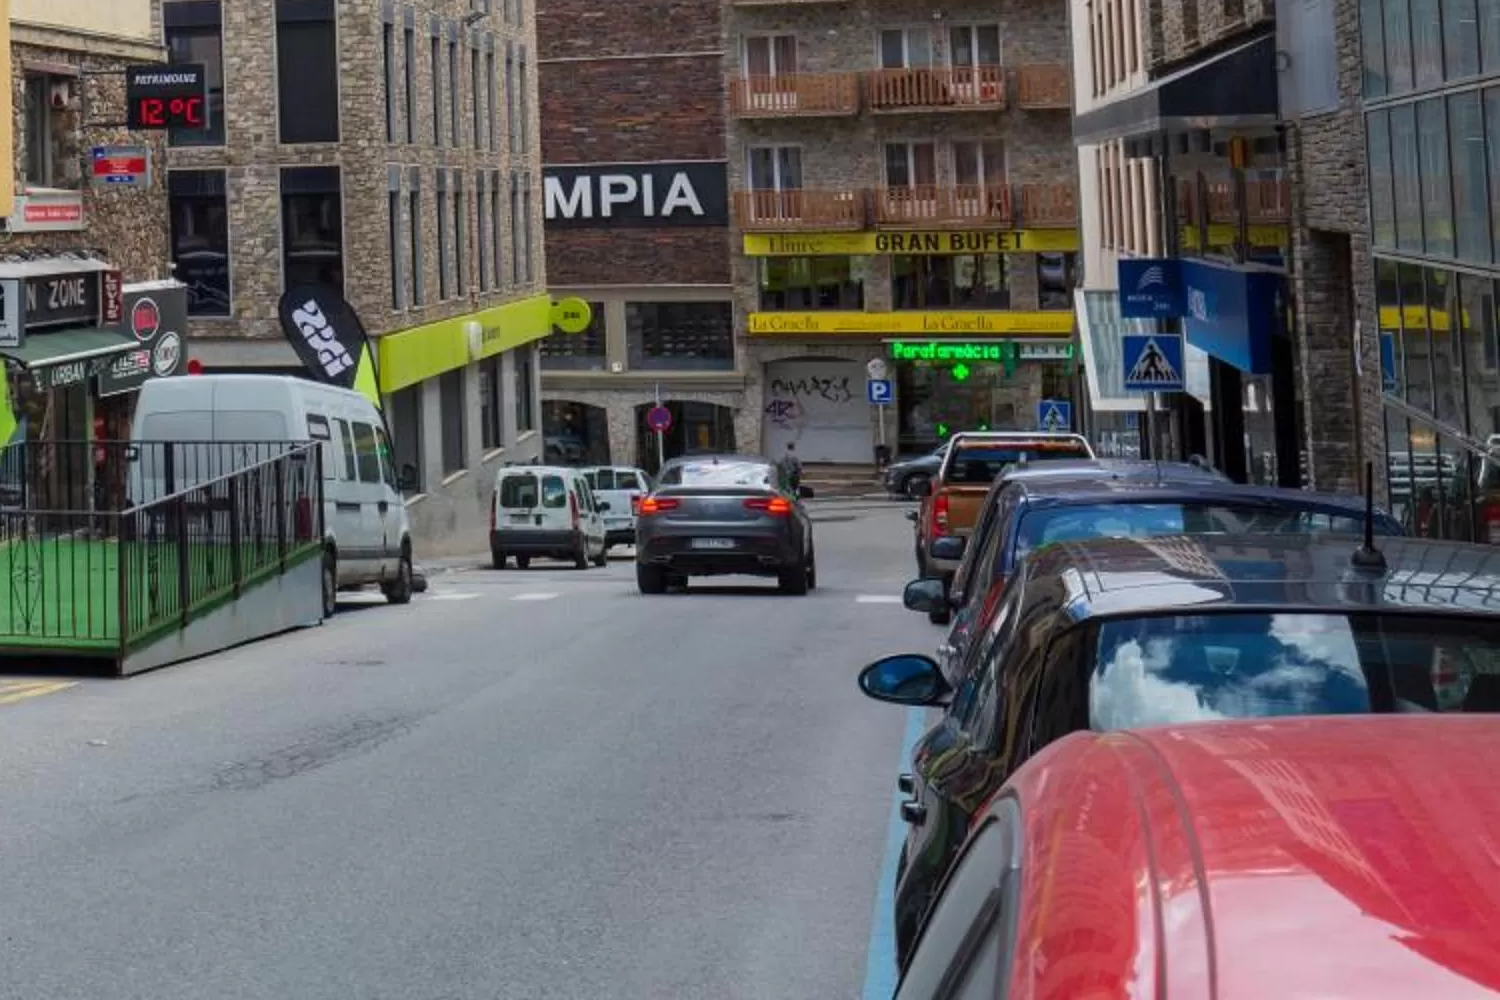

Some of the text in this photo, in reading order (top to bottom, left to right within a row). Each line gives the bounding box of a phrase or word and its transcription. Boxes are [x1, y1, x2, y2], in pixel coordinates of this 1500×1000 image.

[140, 98, 165, 125] 12
[875, 233, 940, 251] GRAN
[951, 231, 1025, 250] BUFET
[50, 278, 86, 309] ZONE
[51, 361, 86, 387] URBAN
[872, 381, 887, 401] P
